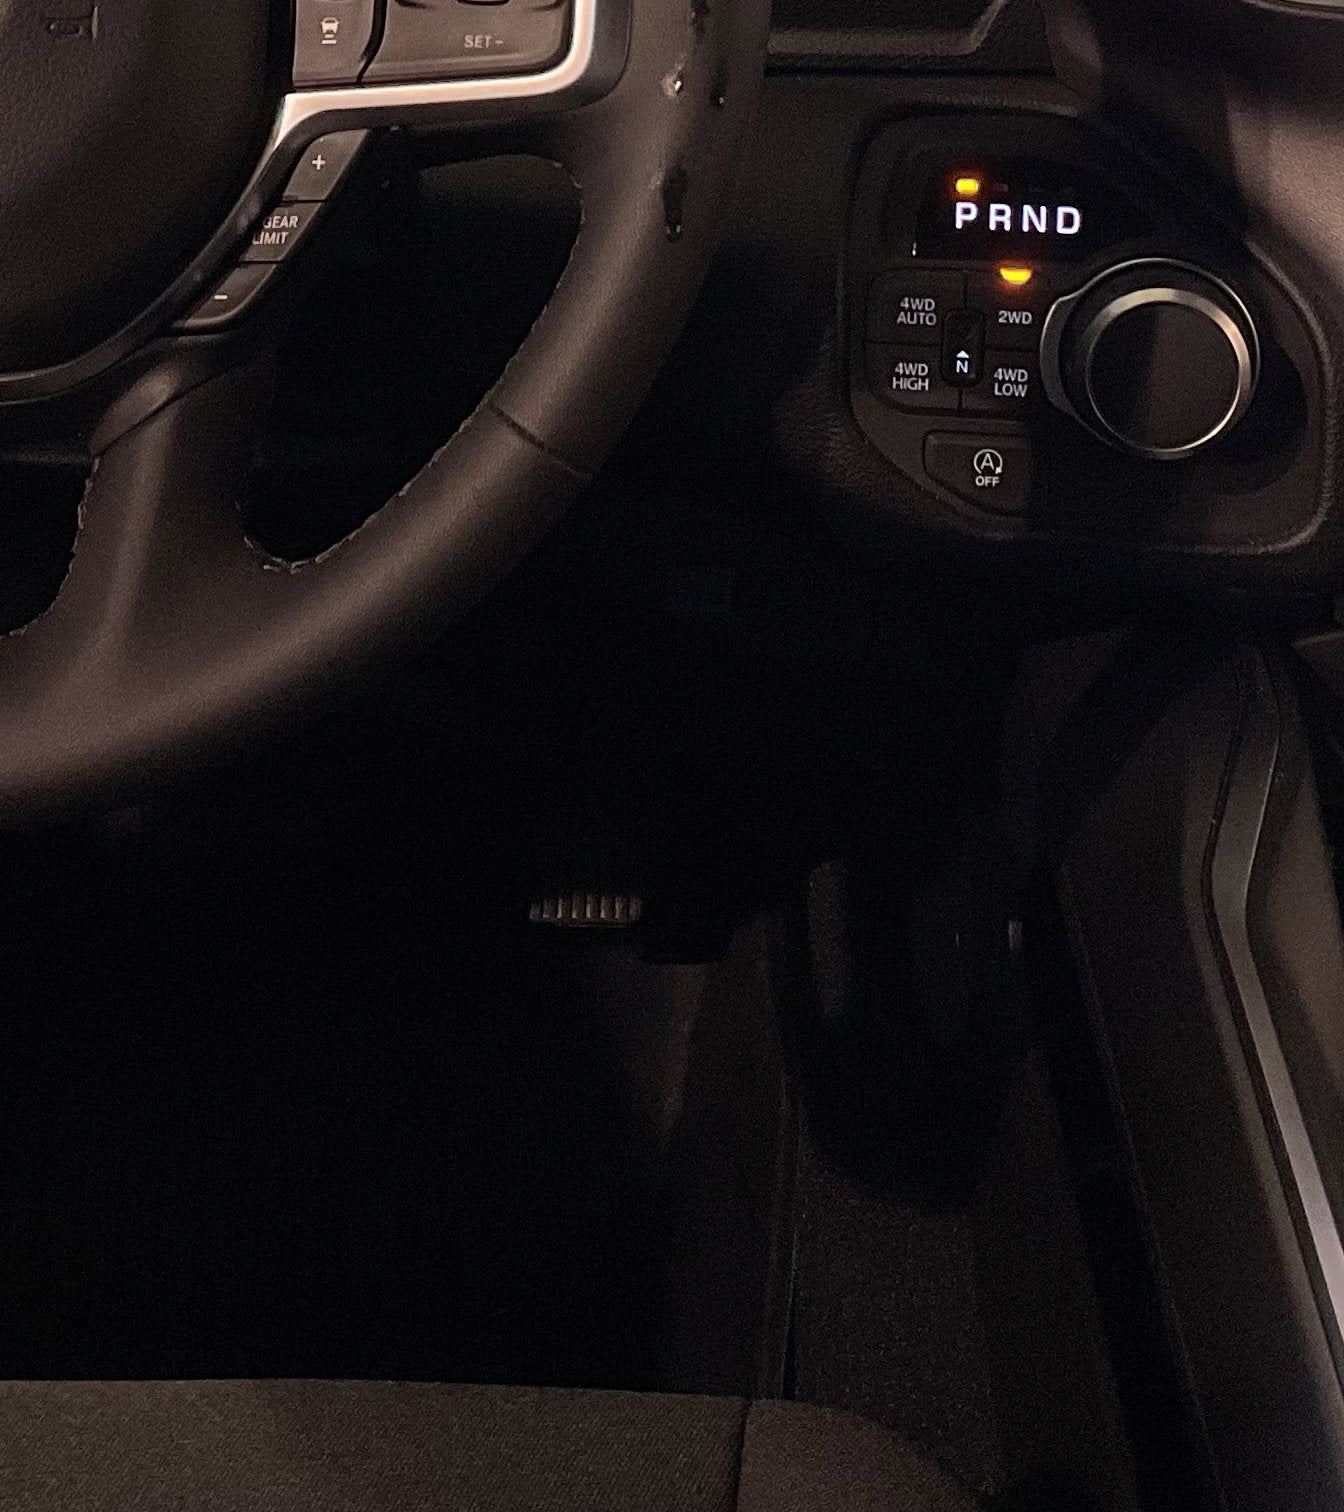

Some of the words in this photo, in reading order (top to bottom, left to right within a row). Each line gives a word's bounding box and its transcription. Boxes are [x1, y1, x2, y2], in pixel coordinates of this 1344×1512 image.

[899, 297, 936, 312] 4WD
[896, 311, 937, 326] AUTO
[998, 310, 1033, 325] 2WD
[894, 363, 929, 377] 4WD
[956, 360, 969, 374] N
[993, 368, 1028, 383] 4WD
[892, 376, 930, 392] HIGH
[993, 382, 1028, 398] LOW
[975, 475, 1001, 488] OFF
